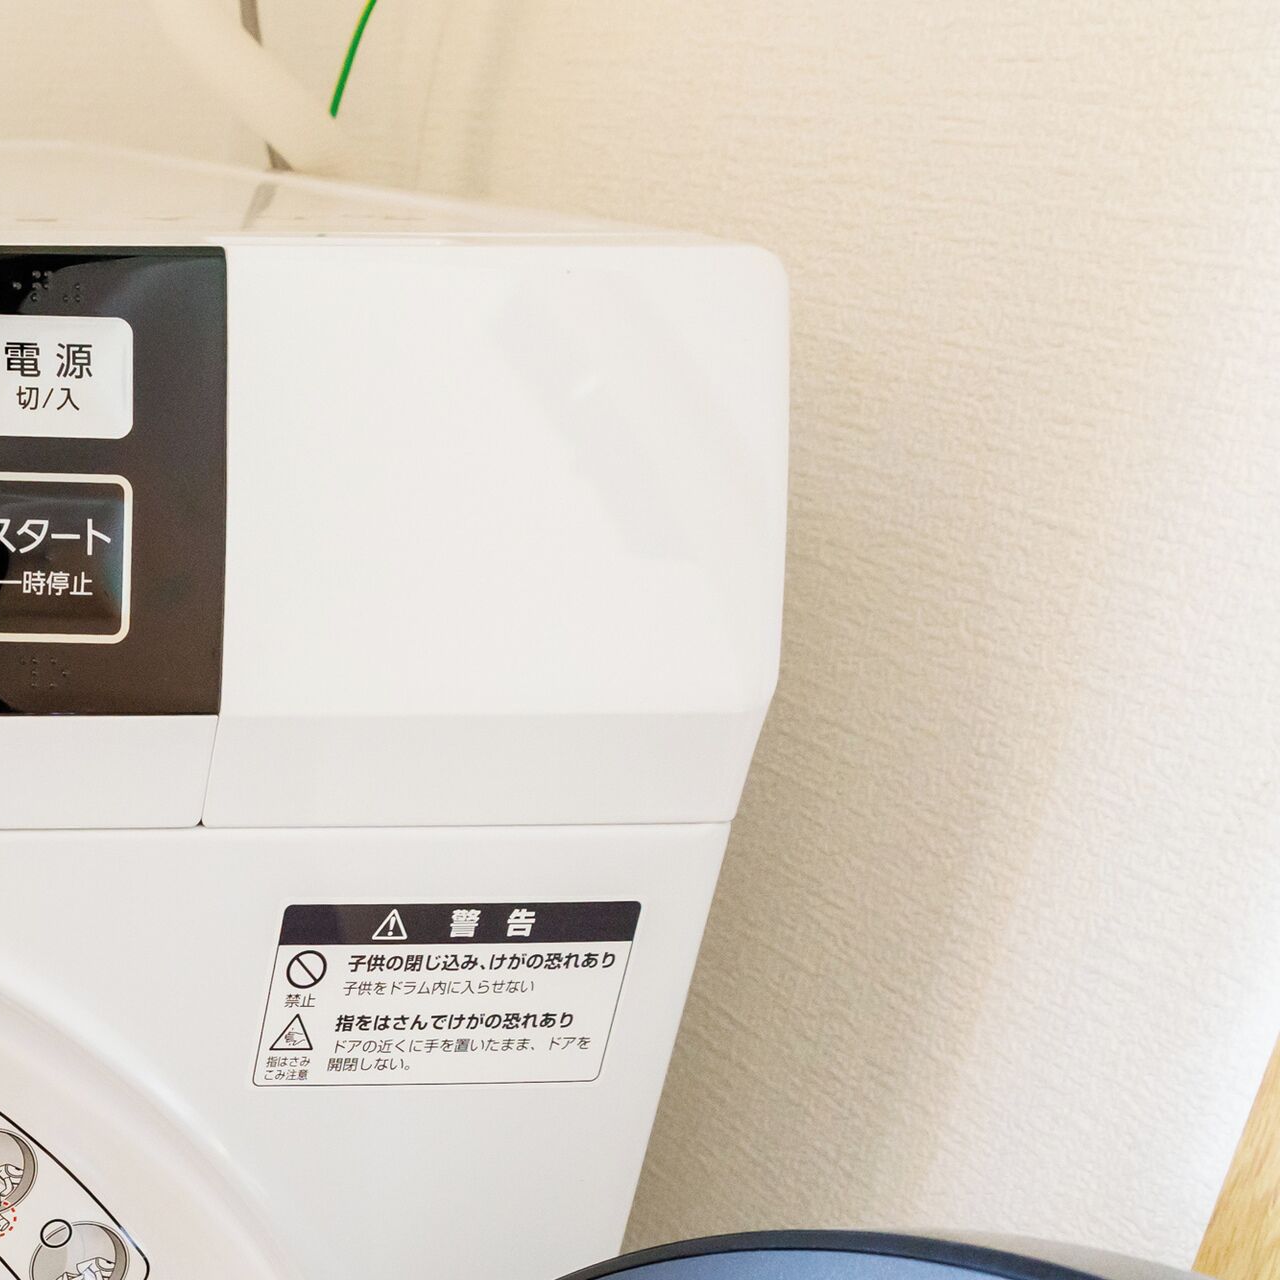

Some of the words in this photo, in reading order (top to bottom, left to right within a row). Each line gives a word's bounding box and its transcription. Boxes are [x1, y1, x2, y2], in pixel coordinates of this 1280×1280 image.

[5, 342, 93, 379] 電源
[17, 387, 80, 412] 切/入
[0, 571, 93, 596] 一時停止
[450, 909, 536, 938] 警告
[342, 980, 535, 996] 子供をドラム内に入らせない
[283, 993, 316, 1008] 禁止
[335, 1012, 574, 1032] 指をはさんでけがの恐れあり
[265, 1055, 310, 1069] 指はさみ
[327, 1057, 412, 1072] 開閉しない。
[264, 1068, 309, 1081] こみ注意
